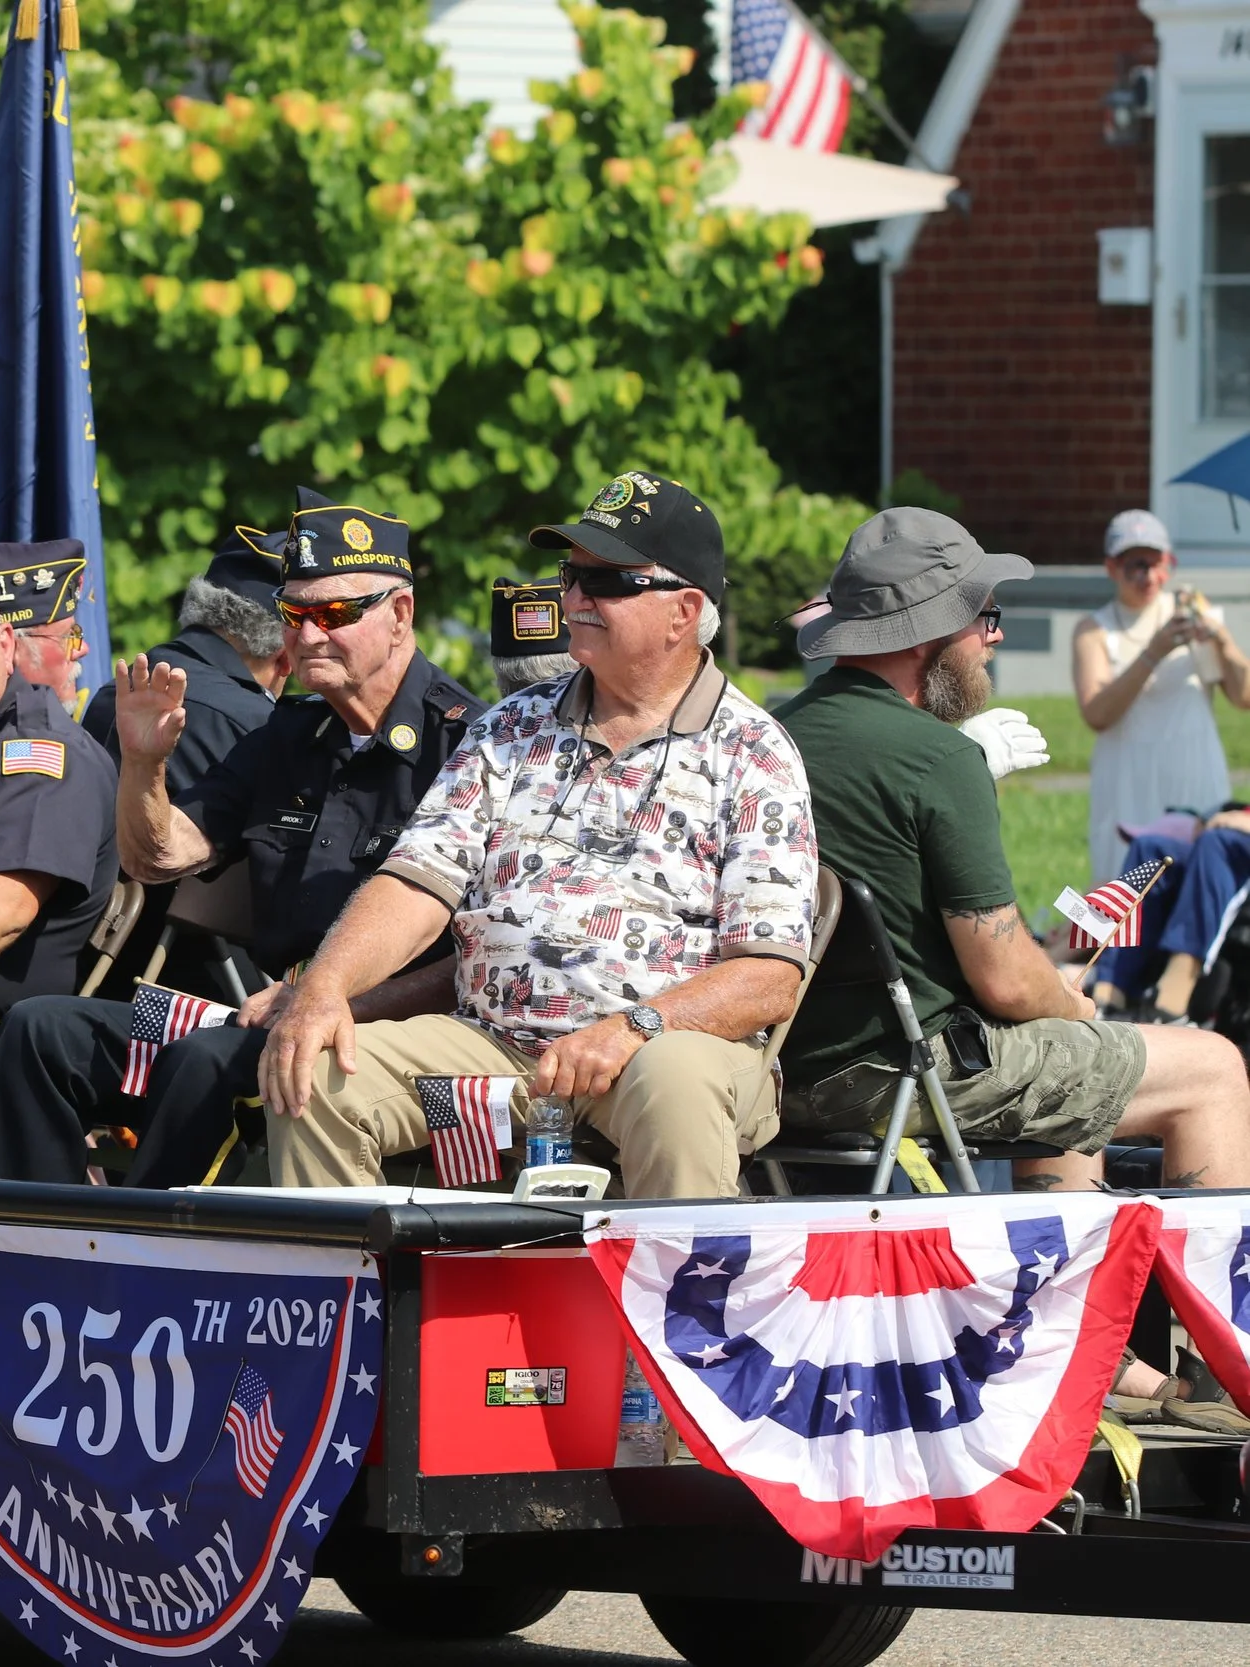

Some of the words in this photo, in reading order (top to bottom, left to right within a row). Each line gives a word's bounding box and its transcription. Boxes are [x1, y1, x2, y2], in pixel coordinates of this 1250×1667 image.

[333, 553, 399, 568] KINGSPORT,
[280, 815, 304, 824] BROOKS
[246, 1296, 338, 1348] 2026
[514, 1370, 540, 1378] IGLOO
[881, 1544, 1016, 1575] CUSTOM
[902, 1573, 995, 1587] TRAILERS
